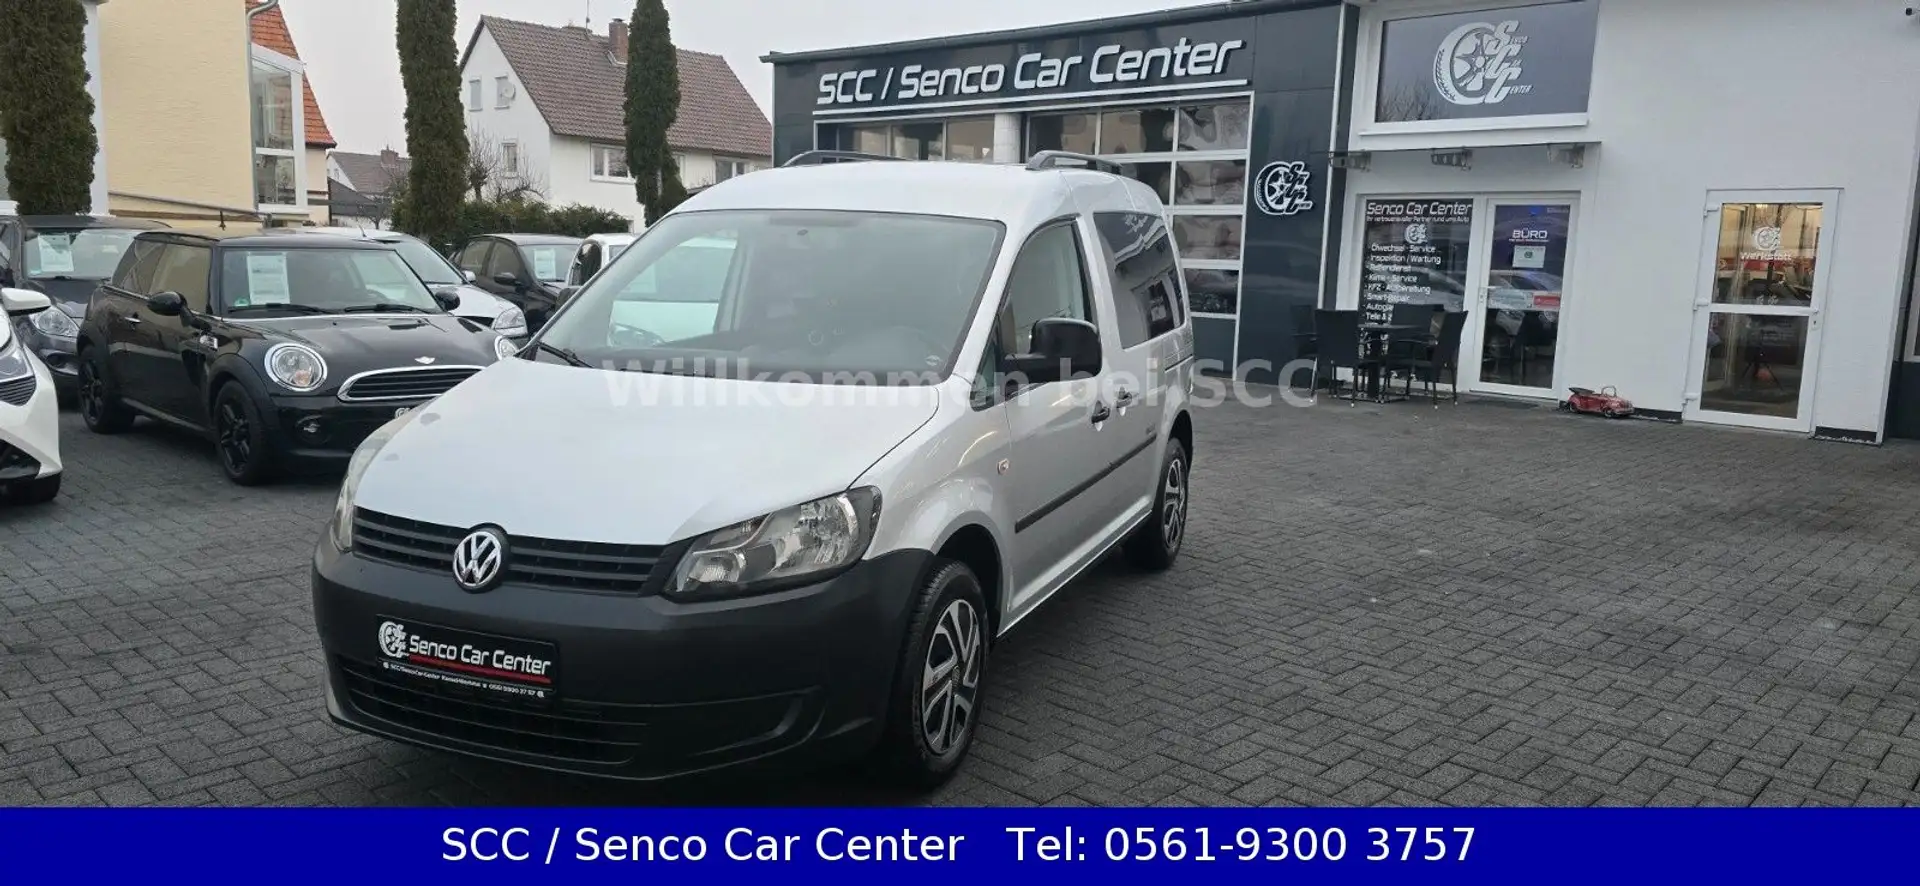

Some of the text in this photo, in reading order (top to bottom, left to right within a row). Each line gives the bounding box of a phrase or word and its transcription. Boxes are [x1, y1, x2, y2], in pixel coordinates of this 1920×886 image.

[816, 36, 1243, 105] SCC / Senco Car Center
[1366, 201, 1473, 215] Senco Car Center
[1512, 227, 1548, 239] BÜRO
[1410, 255, 1442, 265] Wartung
[409, 634, 457, 661] Senco
[460, 644, 490, 666] Car
[492, 649, 552, 675] Center
